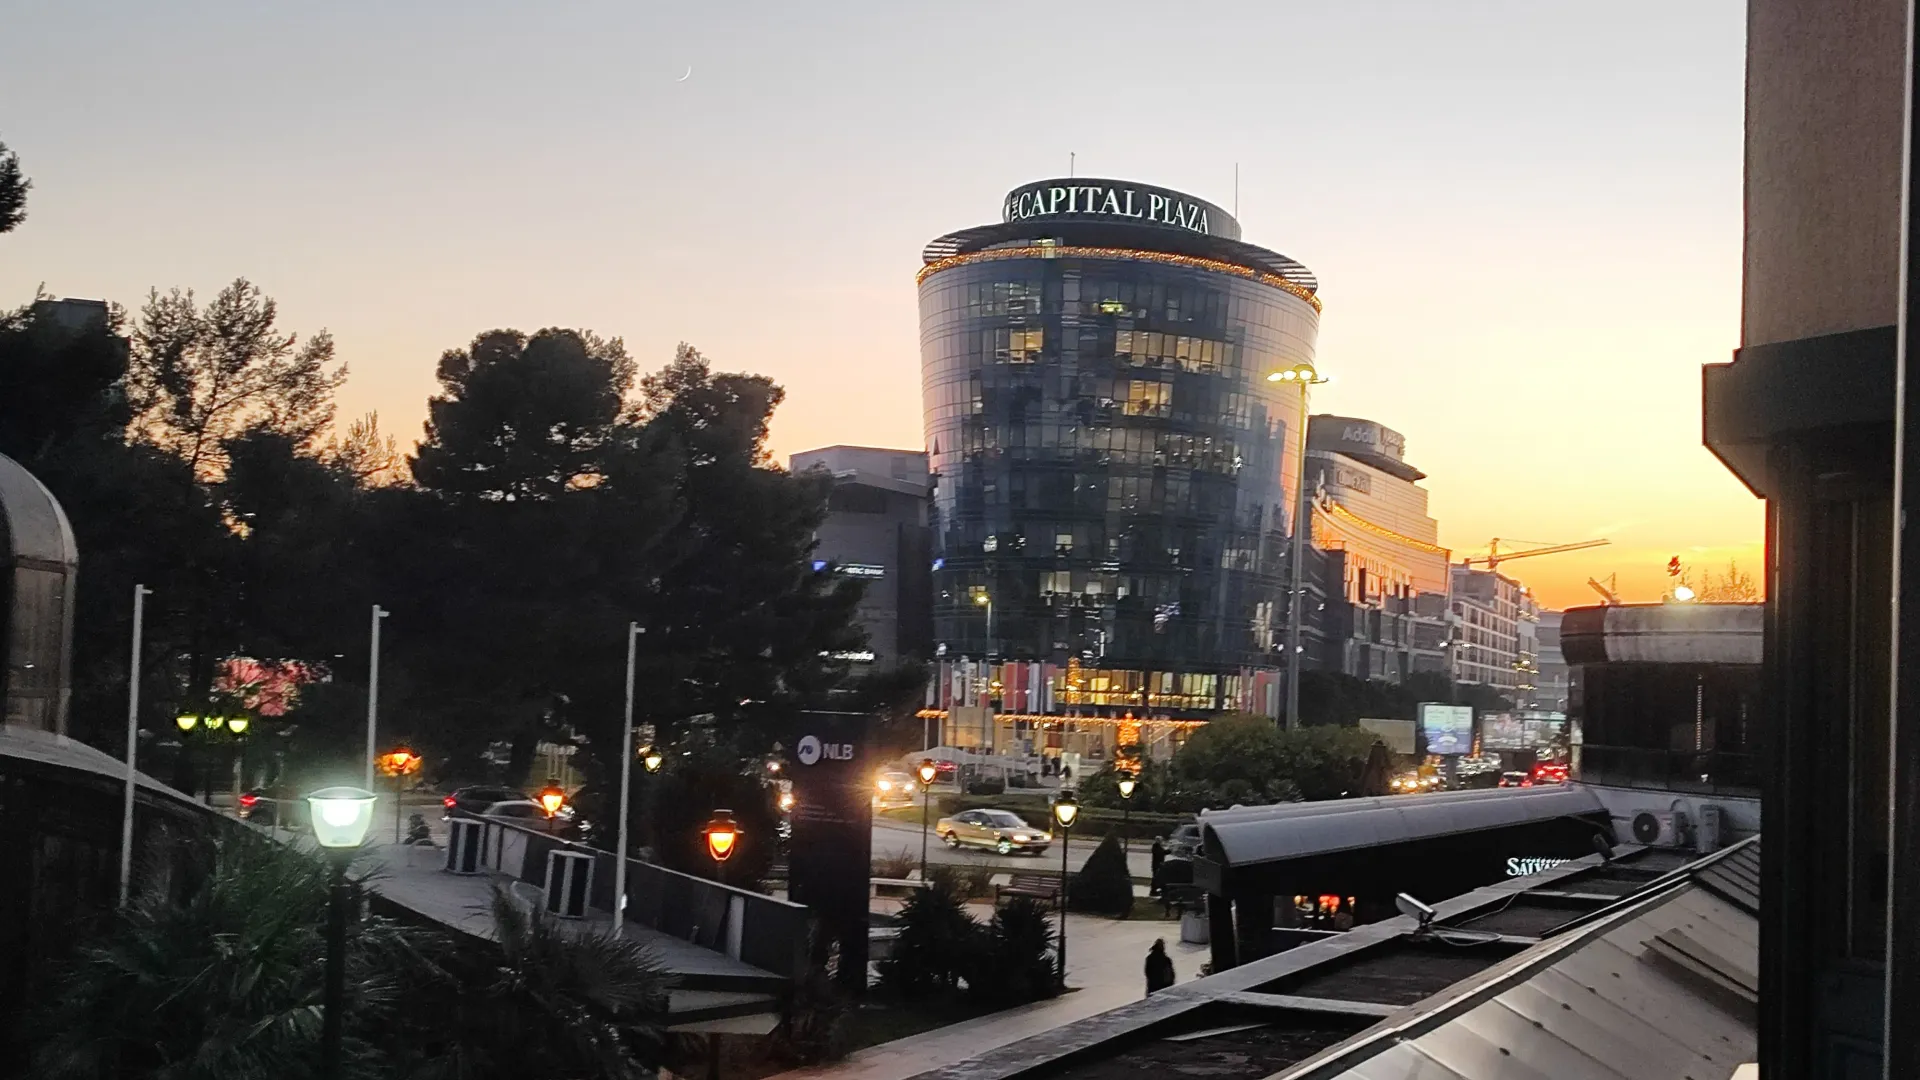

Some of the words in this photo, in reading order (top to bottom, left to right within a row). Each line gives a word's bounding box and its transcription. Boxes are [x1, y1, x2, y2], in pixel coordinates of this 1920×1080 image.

[1010, 196, 1019, 222] THE
[1018, 186, 1143, 219] CAPITAL
[1147, 193, 1210, 235] PLAZA
[823, 743, 853, 760] NLB
